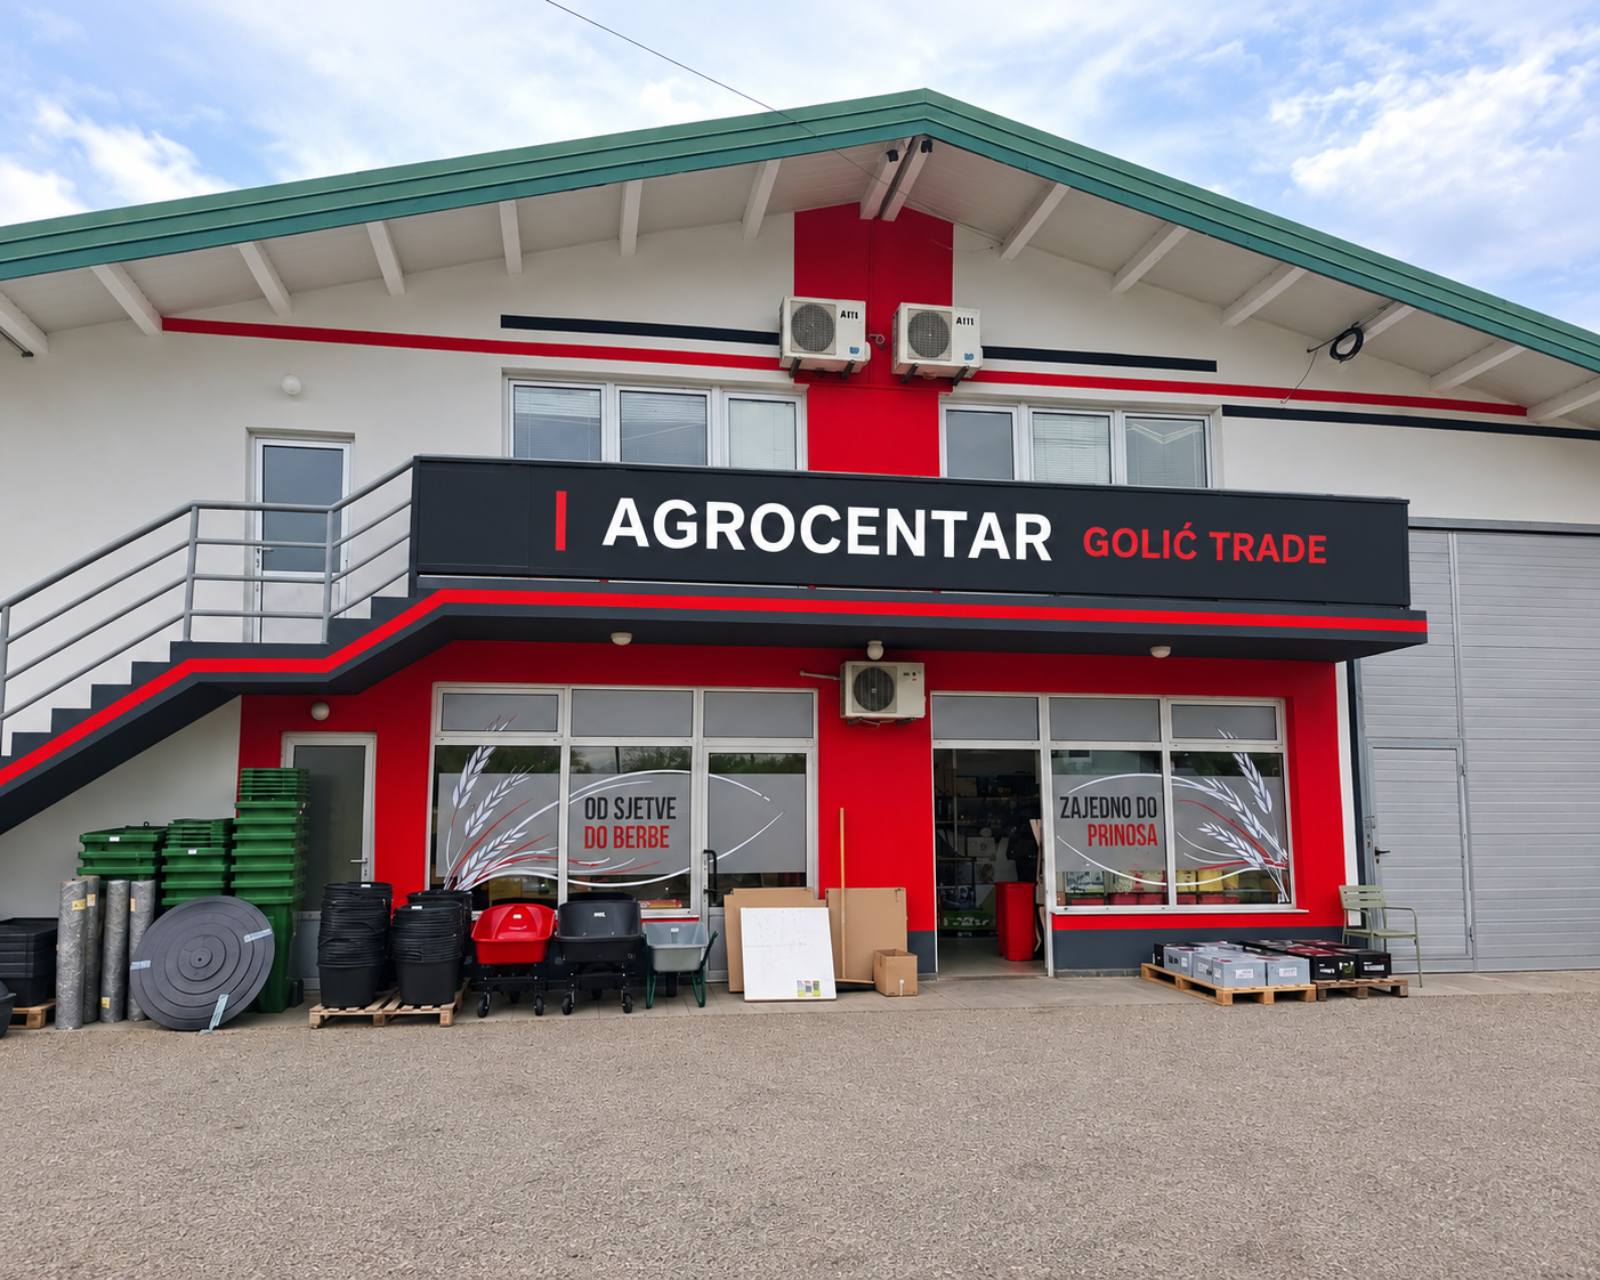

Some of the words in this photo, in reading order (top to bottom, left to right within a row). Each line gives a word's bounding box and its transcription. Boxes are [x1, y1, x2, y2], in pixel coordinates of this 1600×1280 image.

[602, 497, 1052, 562] AGROCENTAR
[1083, 521, 1198, 561] GOLIĆ
[1208, 531, 1328, 565] TRADE
[584, 796, 608, 820] OD
[613, 796, 677, 820] SJETVE
[1060, 796, 1132, 819] ZAJEDNO
[1136, 797, 1158, 819] DO
[584, 825, 608, 849] DO
[613, 825, 670, 849] BERBE
[1088, 823, 1158, 848] PRINOSA
